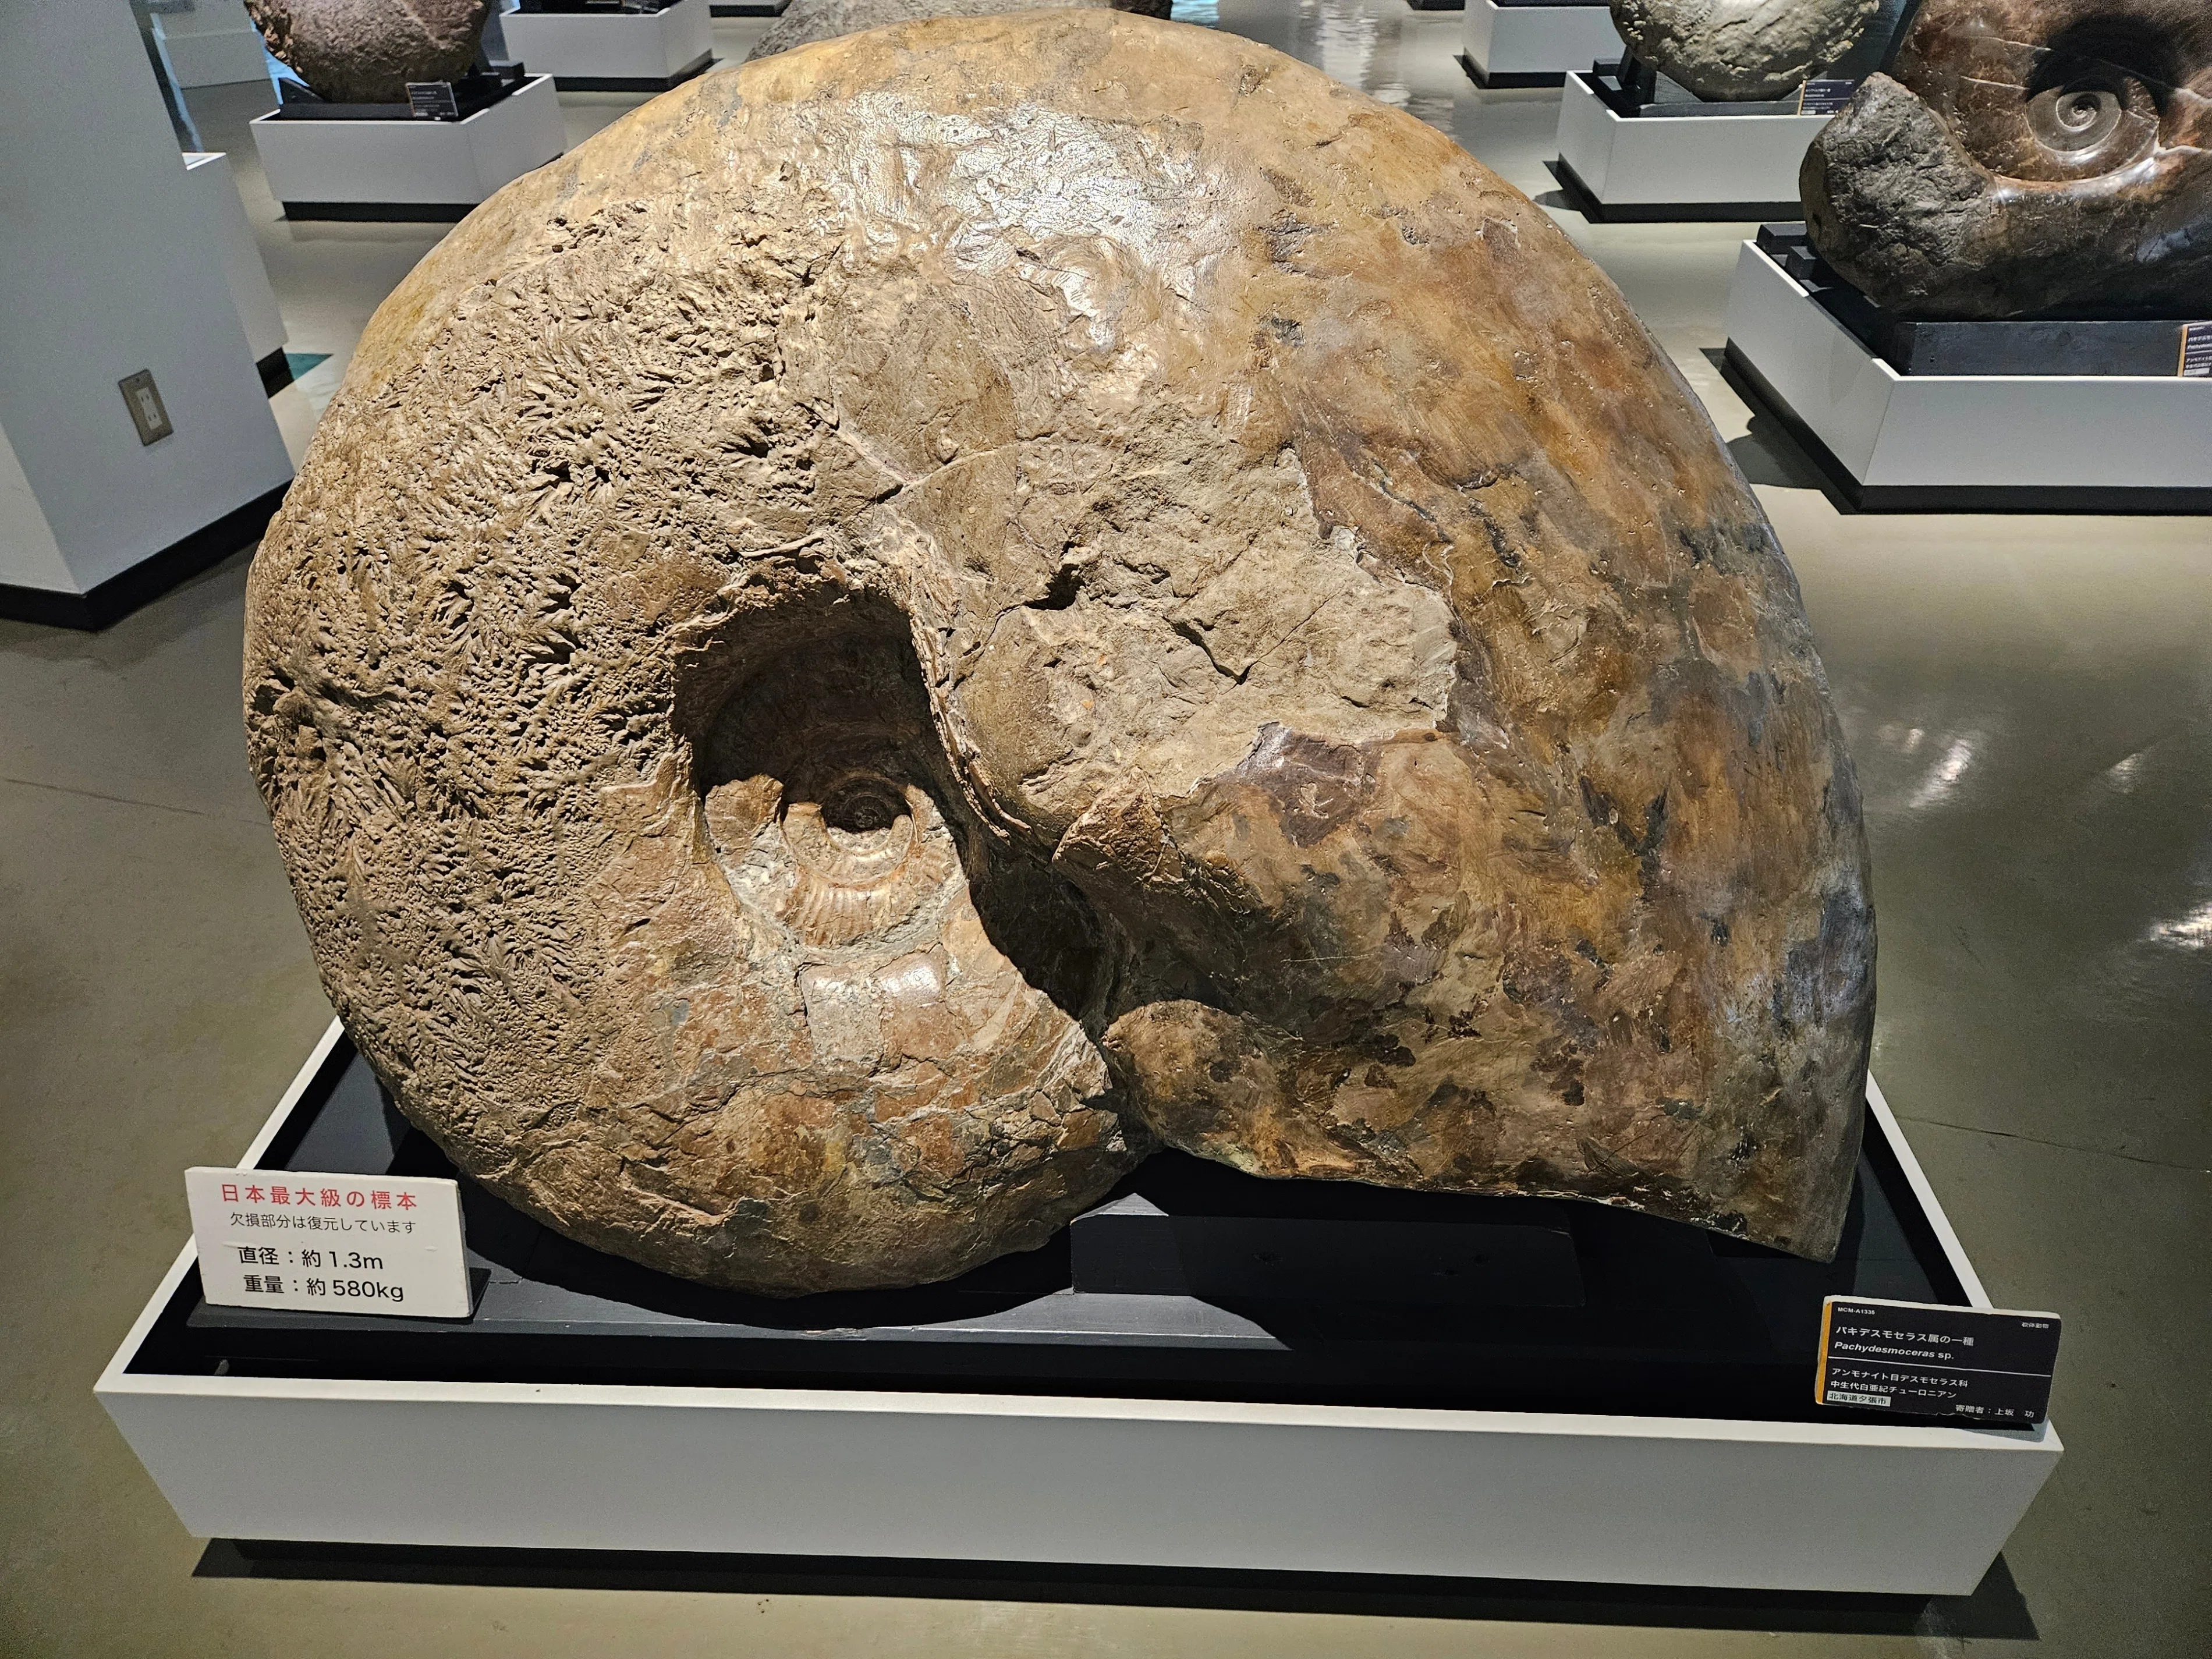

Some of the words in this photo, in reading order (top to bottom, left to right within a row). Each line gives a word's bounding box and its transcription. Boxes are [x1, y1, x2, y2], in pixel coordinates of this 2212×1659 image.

[221, 1183, 417, 1211] 日本最大級の標本
[230, 1211, 416, 1234] 欠損部分は復元しています
[1835, 1325, 1975, 1346] パキデスモセラス属の一種
[1834, 1341, 1936, 1359] Pachydesmoceras
[1938, 1352, 1954, 1360] sp.
[1831, 1367, 1968, 1388] アンモナイト目デスモセラス科
[1828, 1393, 1887, 1405] 北海道夕張市
[1830, 1380, 1957, 1398] 中生代白亜紀チューロニアン
